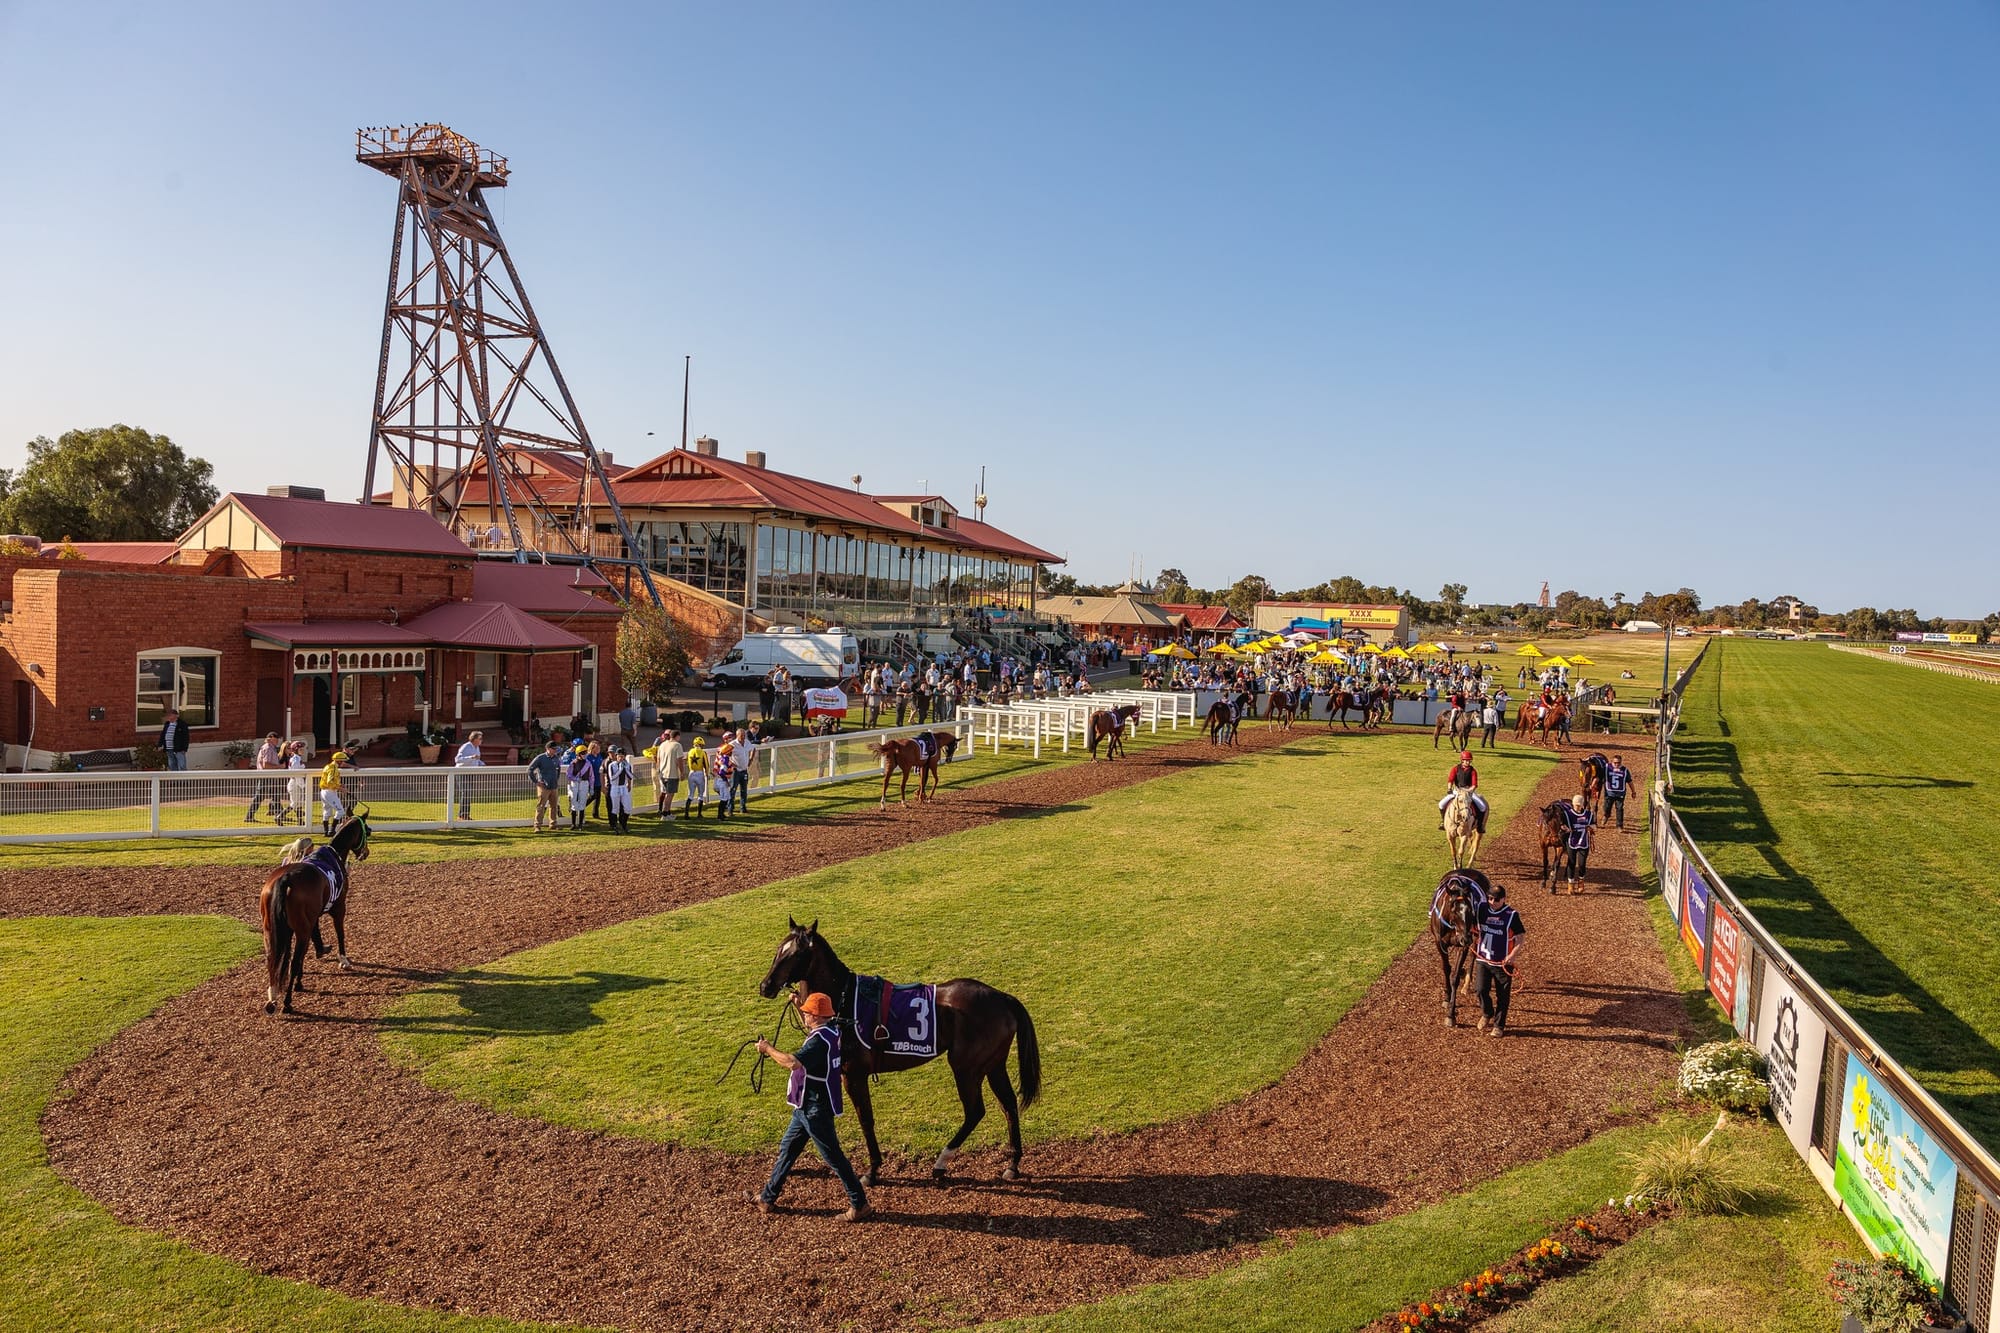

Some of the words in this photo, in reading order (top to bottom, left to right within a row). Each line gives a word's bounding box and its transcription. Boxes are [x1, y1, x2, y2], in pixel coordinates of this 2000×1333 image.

[1349, 609, 1372, 617] XXXX
[919, 740, 928, 755] 2
[1611, 775, 1620, 789] 5
[1577, 828, 1586, 846] 7
[1480, 932, 1495, 960] 4
[1720, 916, 1737, 956] KENT
[907, 997, 930, 1041] 3
[891, 1041, 932, 1053] TABtouch
[1869, 1108, 1889, 1150] Little
[1863, 1120, 1897, 1191] Loads
